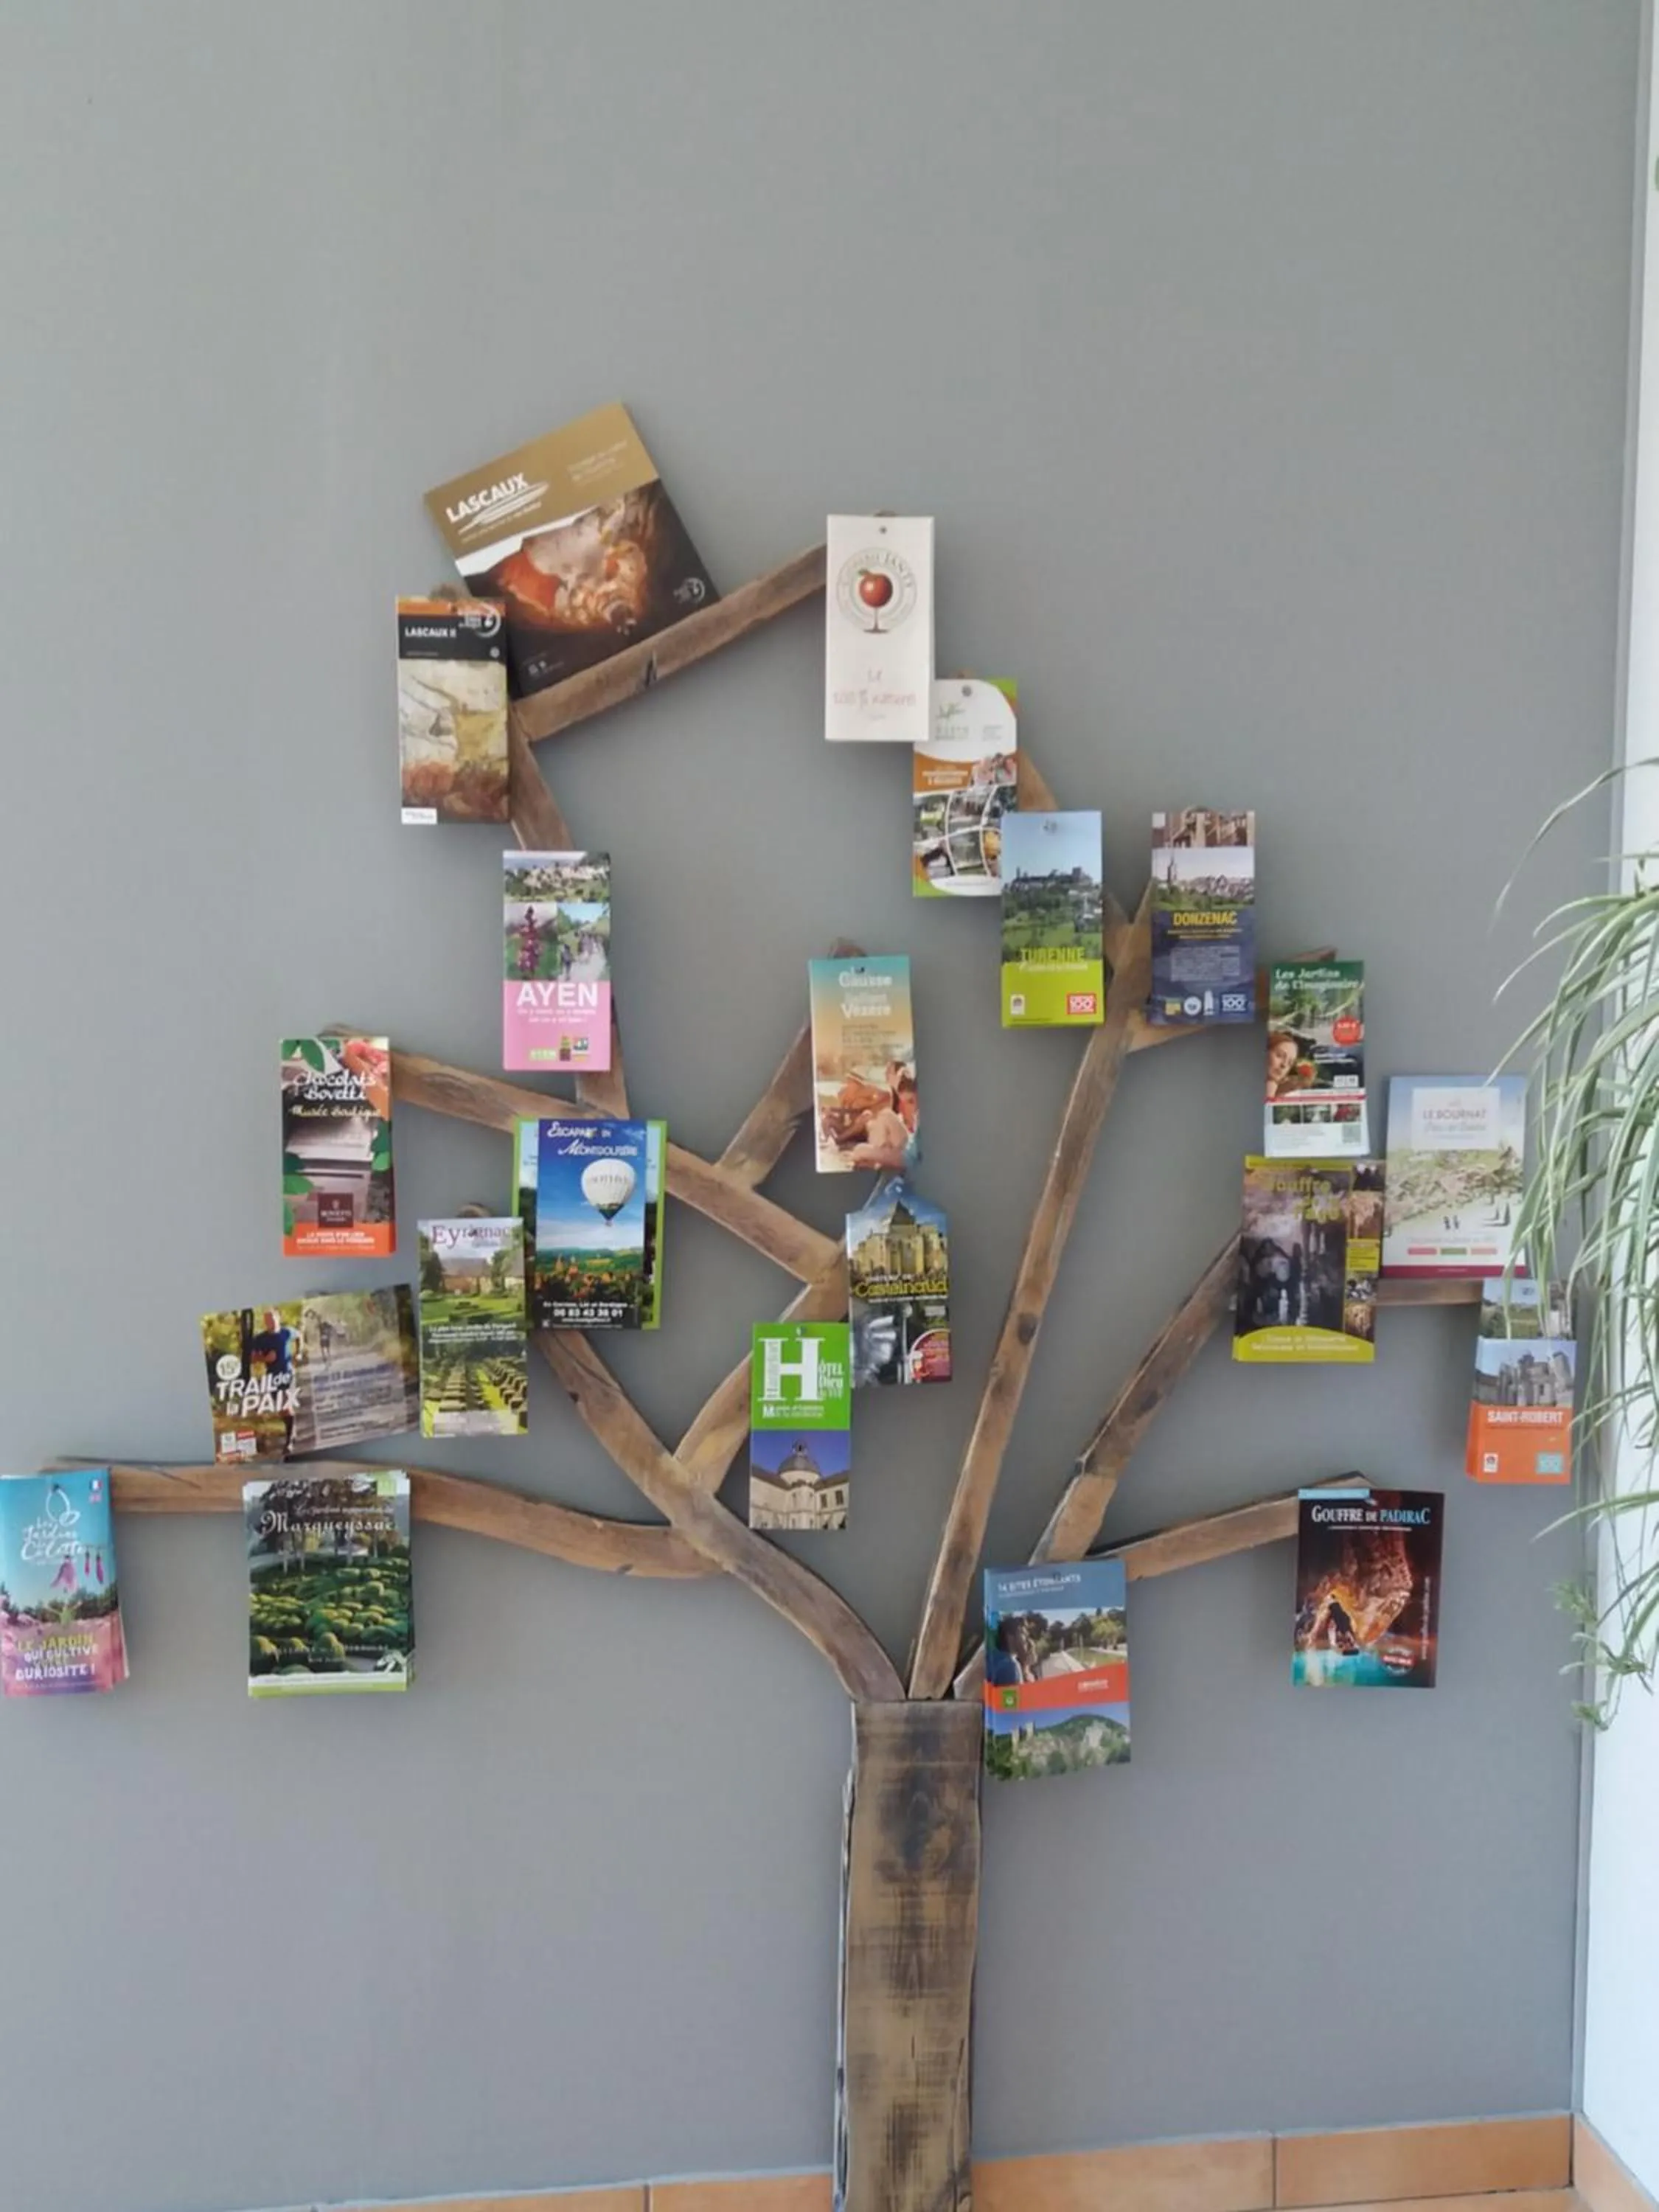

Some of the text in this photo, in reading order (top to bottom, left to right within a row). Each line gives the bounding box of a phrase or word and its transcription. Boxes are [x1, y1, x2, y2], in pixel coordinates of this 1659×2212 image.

[445, 472, 529, 524] LASCAUX
[404, 627, 448, 637] LASCAUX
[1173, 910, 1238, 926] DONZENAC
[1020, 947, 1085, 962] TURENNE
[839, 971, 892, 988] Causse
[516, 982, 598, 1006] AYEN
[432, 1225, 511, 1250] Eyrgnac
[216, 1372, 291, 1402] TRAIL de
[241, 1387, 301, 1418] PAIX
[1486, 1411, 1563, 1423] SAINT-ROBERT
[1312, 1505, 1363, 1523] GOUFFRE
[1380, 1508, 1430, 1524] PADIRAC
[260, 1510, 396, 1541] Marqueyssac
[42, 1633, 94, 1649] JARDIN
